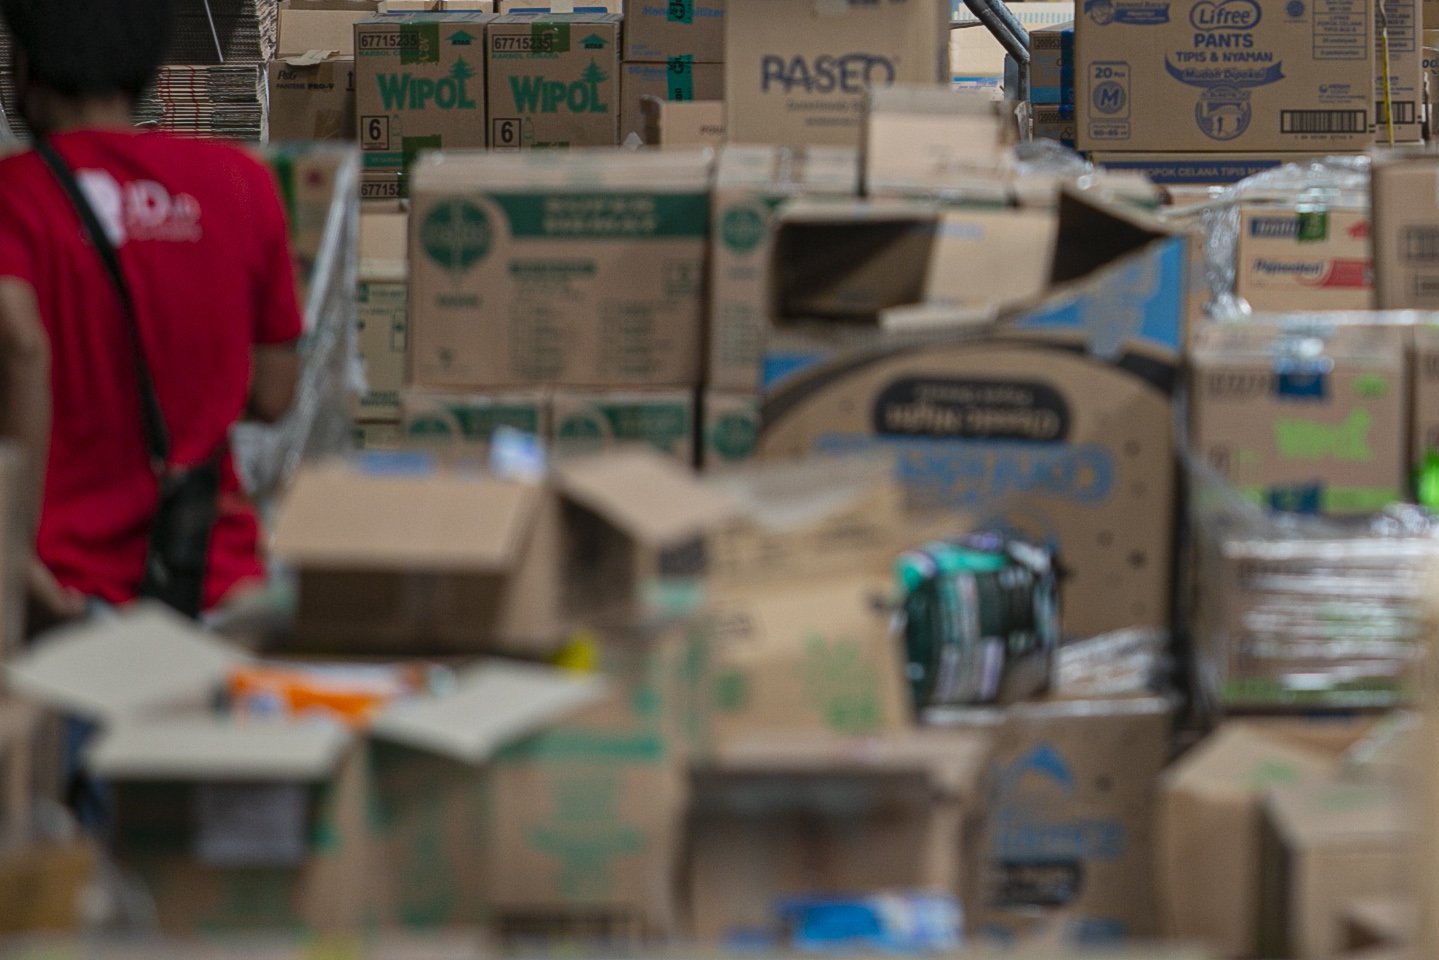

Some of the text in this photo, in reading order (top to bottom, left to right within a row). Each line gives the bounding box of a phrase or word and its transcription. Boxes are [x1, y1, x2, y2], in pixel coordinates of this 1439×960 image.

[1199, 7, 1251, 26] Lifree
[494, 35, 550, 51] 67715235
[1194, 33, 1254, 48] PANTS
[1176, 51, 1273, 62] TIPIS & NYAMAN
[760, 51, 897, 94] PASEO
[1094, 67, 1112, 79] 20
[376, 71, 477, 111] WIPOL
[508, 75, 609, 113] WIPOL
[1098, 88, 1120, 107] M
[368, 118, 381, 140] 6
[501, 120, 513, 143] 6
[1178, 167, 1218, 177] CELANA
